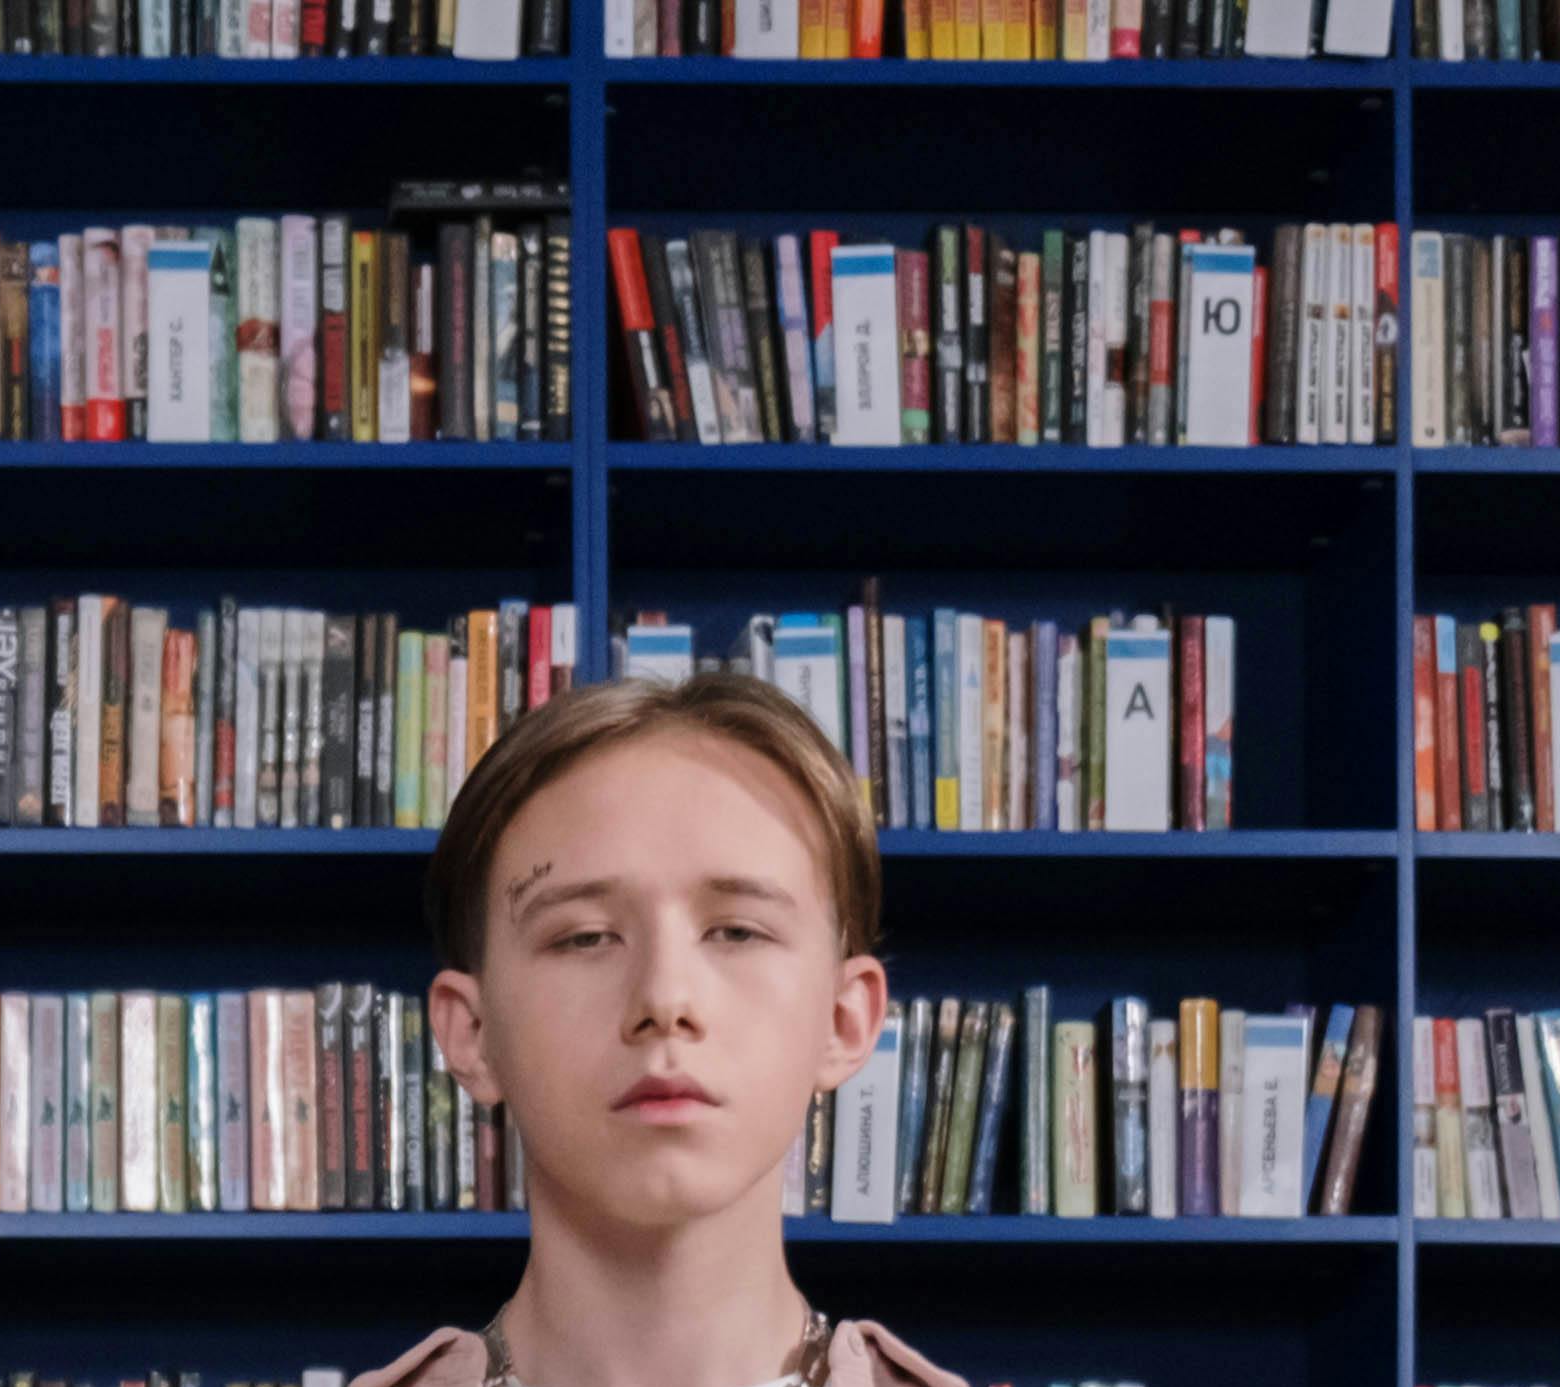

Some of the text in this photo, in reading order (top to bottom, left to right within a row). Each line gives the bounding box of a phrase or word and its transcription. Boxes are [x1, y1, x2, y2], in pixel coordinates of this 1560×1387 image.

[1203, 297, 1243, 335] Ю
[169, 336, 185, 402] ХАНТЕР
[1123, 681, 1155, 720] А
[856, 1103, 874, 1196] АЛЮШИНА
[1261, 1095, 1279, 1195] АРСЕНЬЕВА
